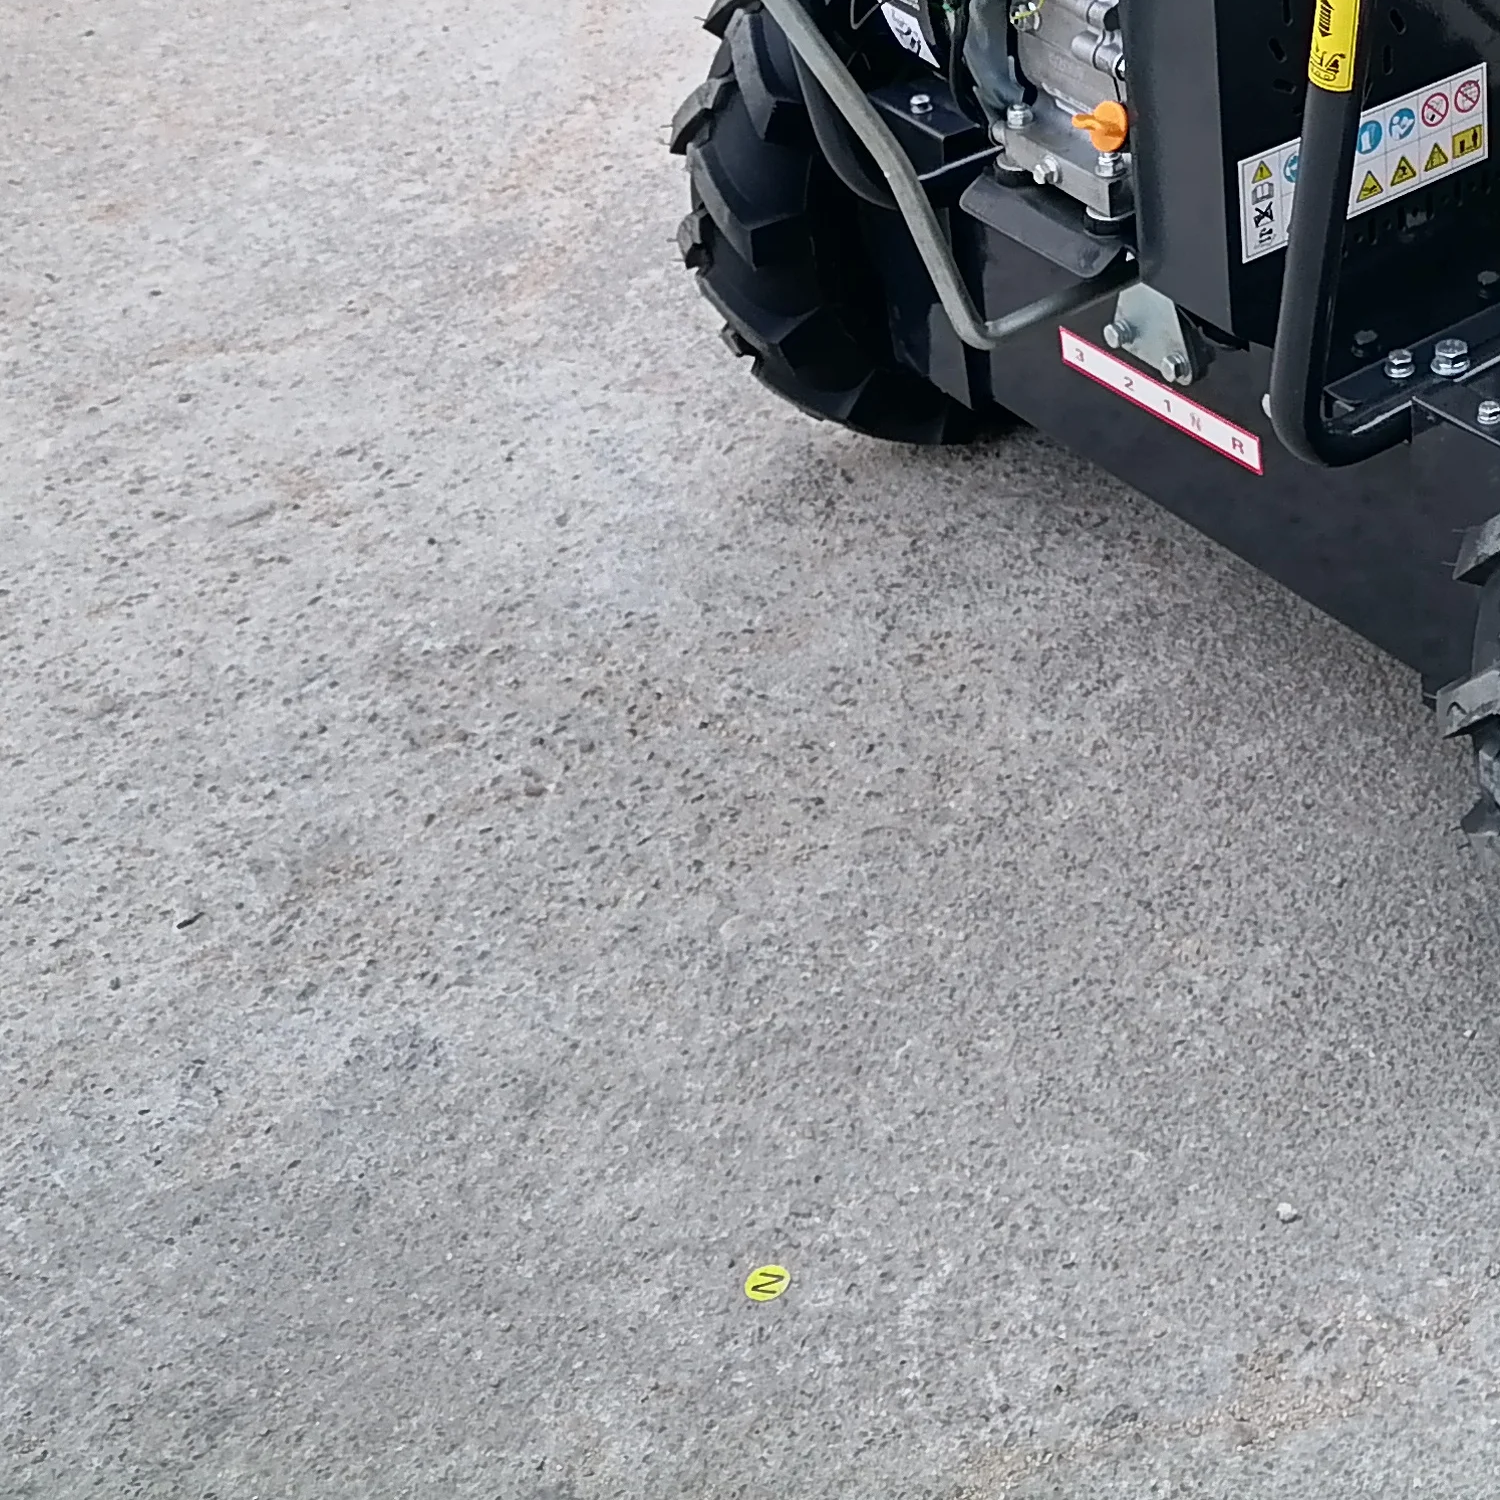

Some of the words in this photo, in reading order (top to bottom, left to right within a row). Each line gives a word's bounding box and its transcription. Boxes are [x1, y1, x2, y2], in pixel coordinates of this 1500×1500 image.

[1074, 347, 1086, 363] 3
[1123, 376, 1135, 392] 2
[1163, 399, 1172, 413] 1
[1231, 436, 1245, 455] R
